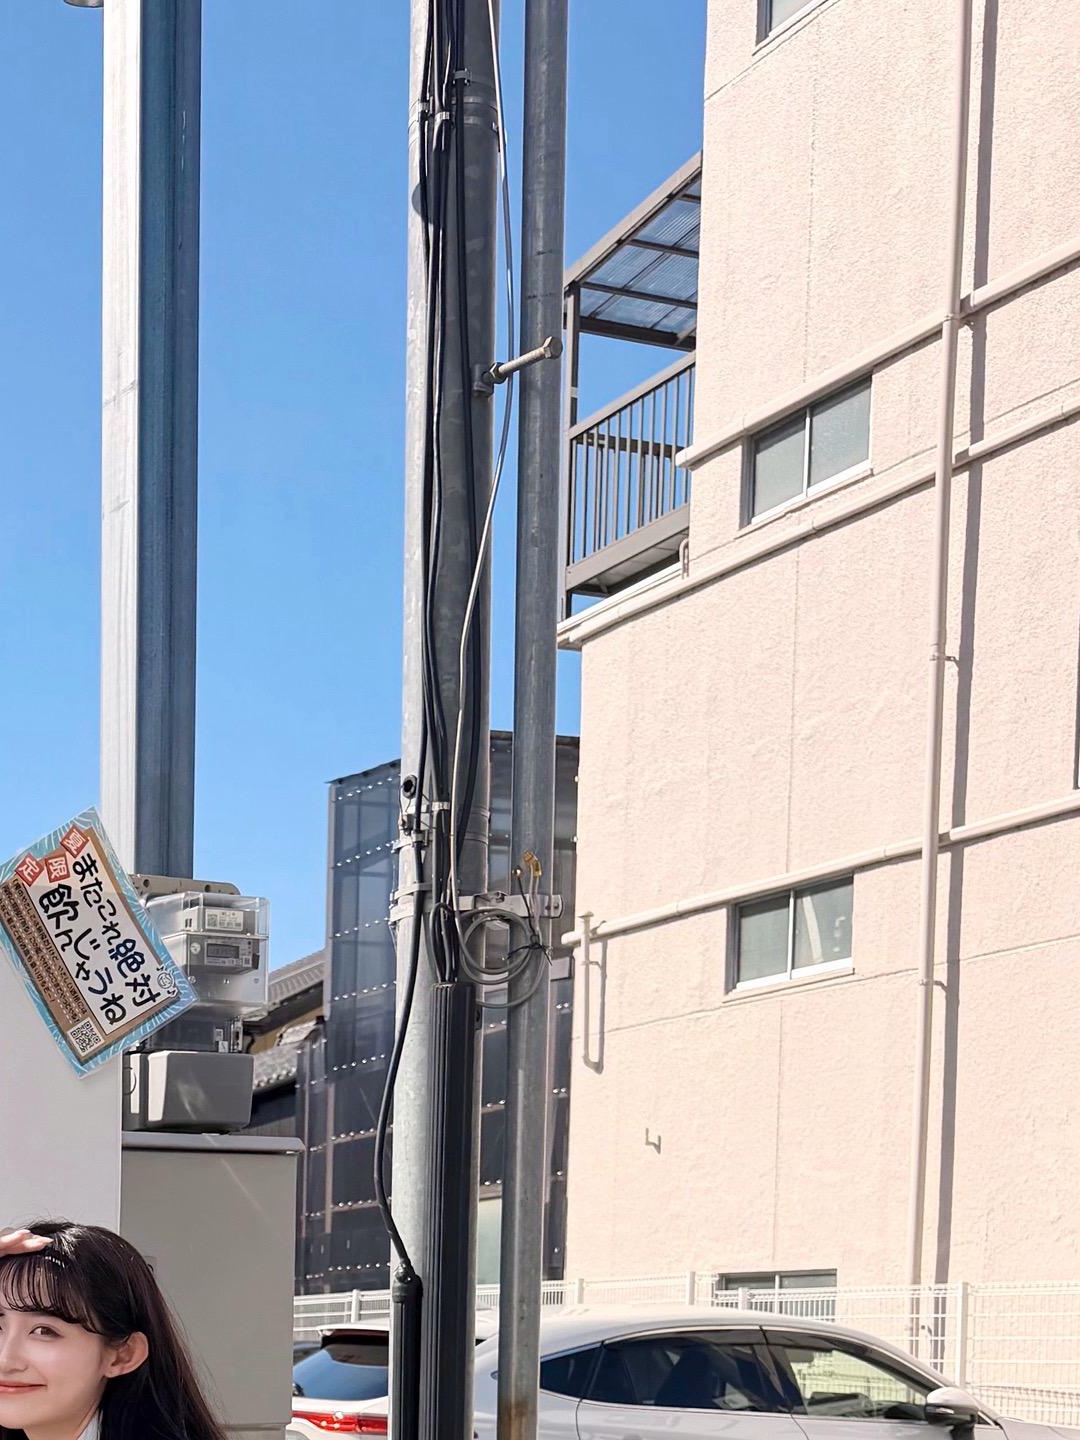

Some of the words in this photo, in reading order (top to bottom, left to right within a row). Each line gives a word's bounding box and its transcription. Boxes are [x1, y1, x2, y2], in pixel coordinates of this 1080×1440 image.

[39, 883, 126, 1026] 飲んじゃうね
[73, 852, 161, 1007] またこれ絶対
